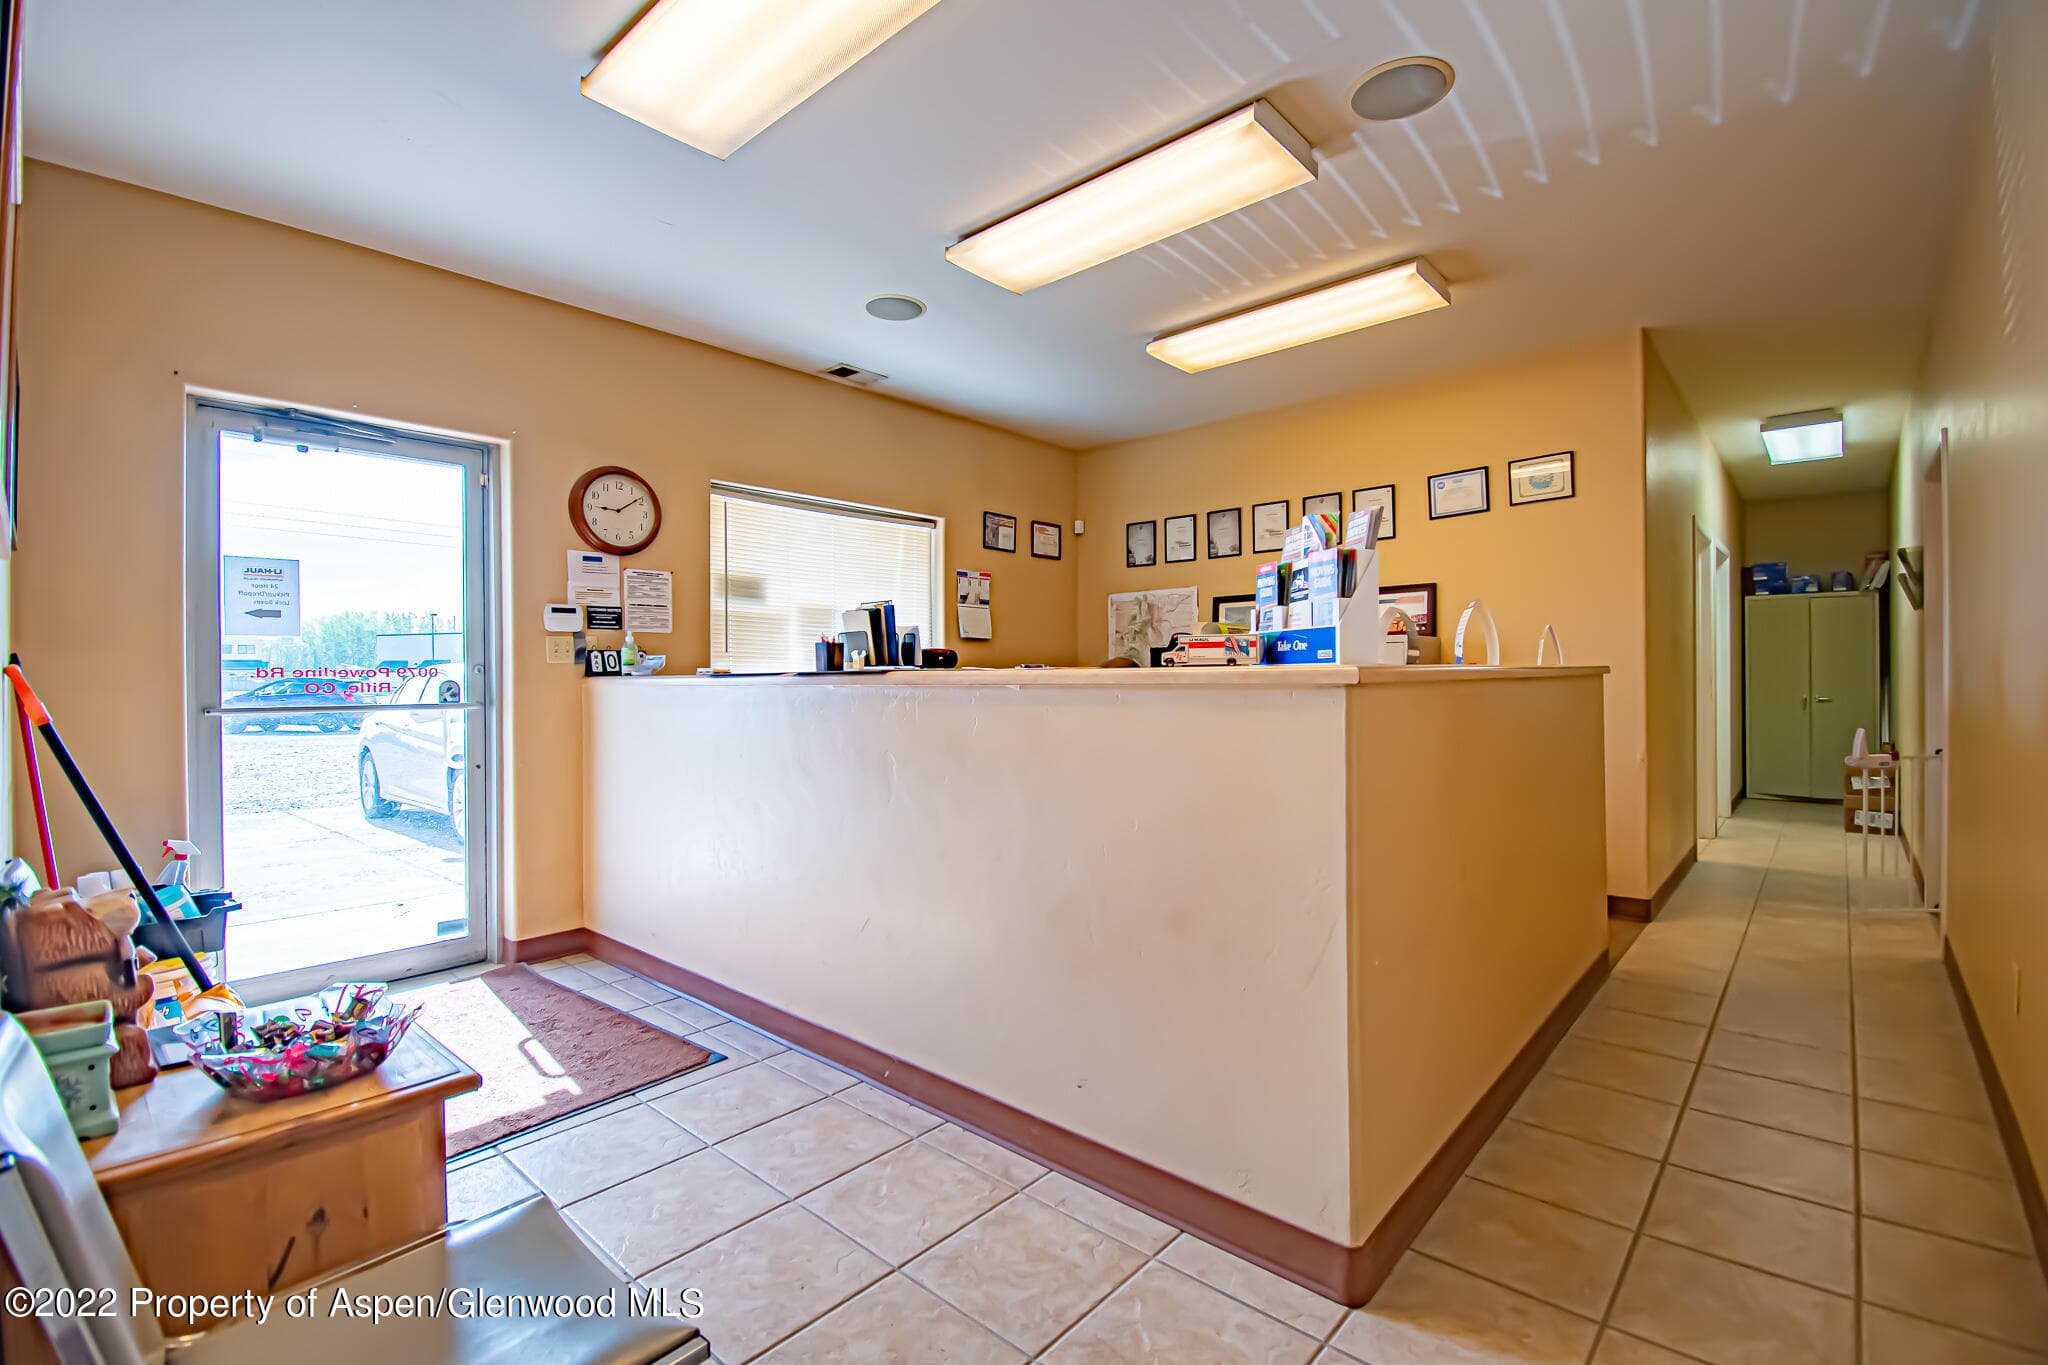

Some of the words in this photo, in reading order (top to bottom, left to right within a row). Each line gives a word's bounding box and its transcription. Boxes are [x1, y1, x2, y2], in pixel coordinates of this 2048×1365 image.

[602, 483, 609, 492] 11
[615, 481, 624, 490] 12
[592, 491, 600, 500] 10
[638, 497, 644, 506] 2
[587, 503, 593, 511] 9
[592, 518, 597, 526] 8
[615, 533, 621, 541] 6
[628, 531, 634, 540] 5
[1277, 641, 1291, 652] Take
[1293, 640, 1308, 651] One
